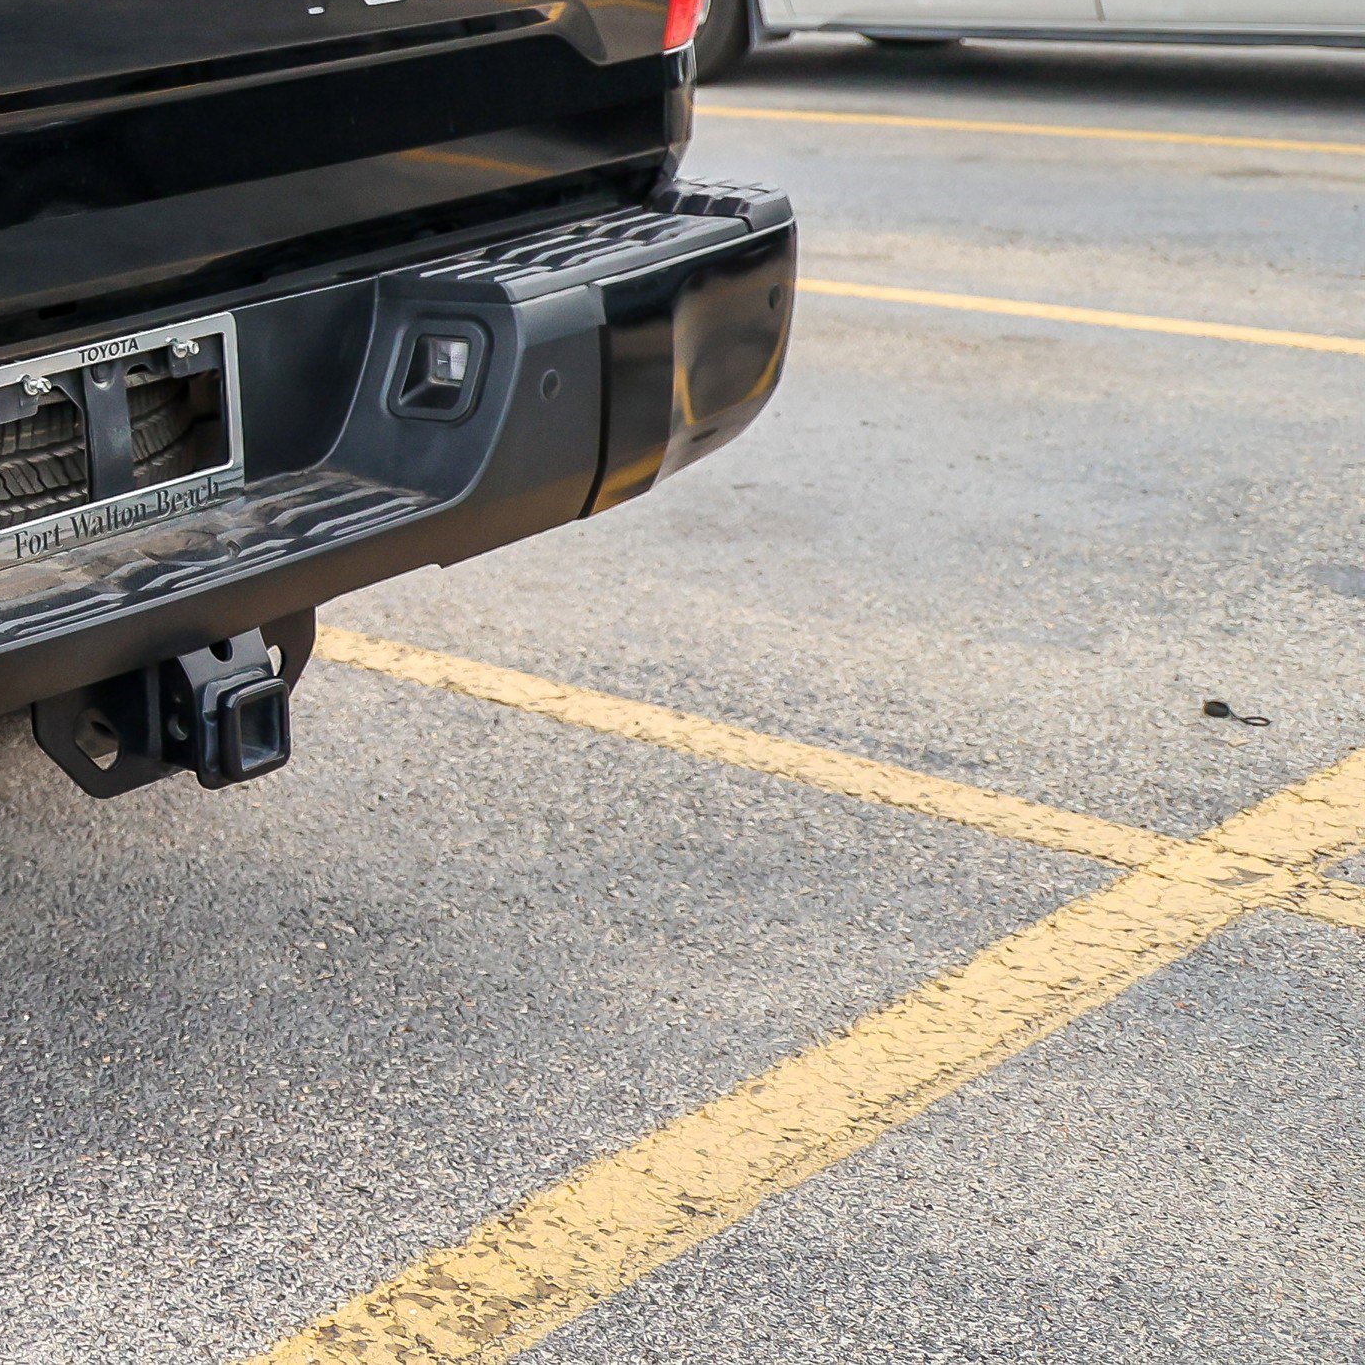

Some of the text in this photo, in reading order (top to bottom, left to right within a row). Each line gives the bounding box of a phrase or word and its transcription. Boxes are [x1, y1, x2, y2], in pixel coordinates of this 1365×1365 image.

[78, 338, 140, 365] TOYOTA
[14, 476, 220, 559] Fort Walton Beach
